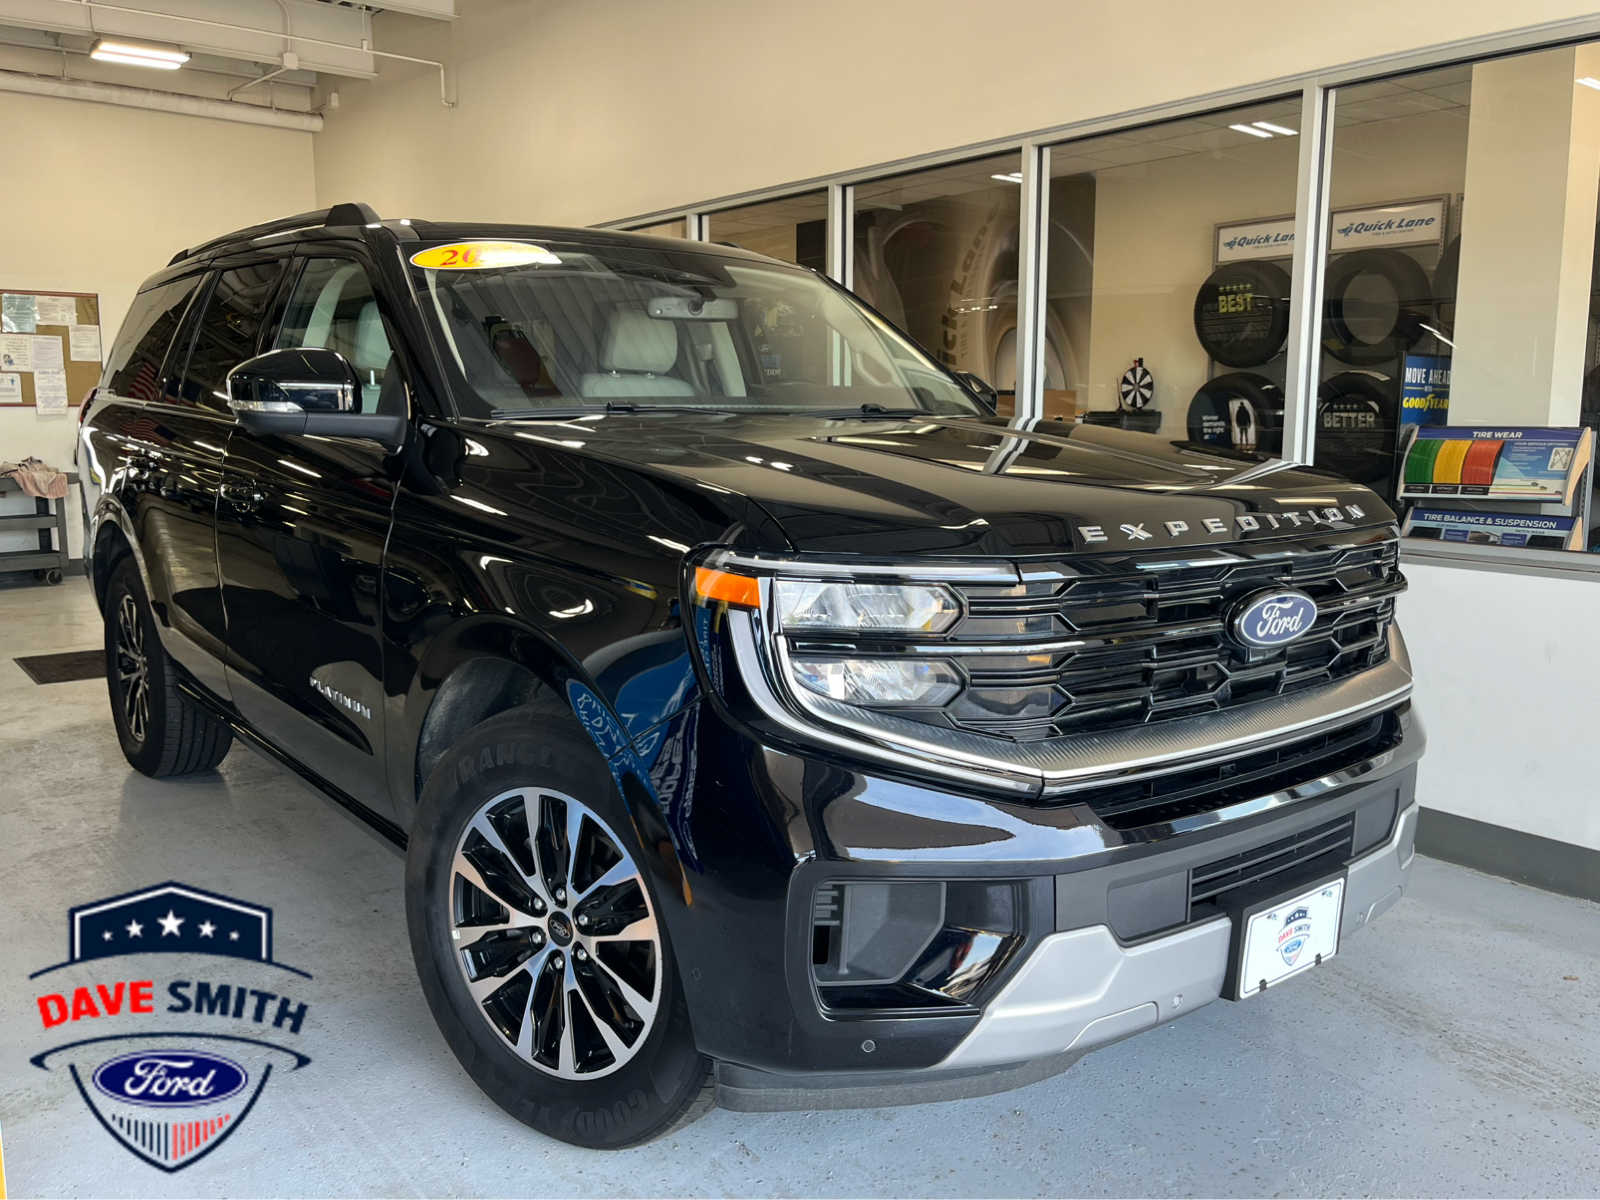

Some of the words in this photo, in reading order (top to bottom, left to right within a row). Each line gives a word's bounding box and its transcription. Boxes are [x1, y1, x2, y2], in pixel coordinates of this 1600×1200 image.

[1352, 219, 1393, 234] Quick
[1396, 216, 1436, 229] Lane
[1237, 233, 1272, 248] Quick
[1273, 232, 1296, 242] Lan
[1218, 293, 1252, 313] BEST
[1405, 368, 1426, 383] MOVE
[1323, 411, 1375, 428] BETTER
[1473, 431, 1493, 439] TIRE
[1494, 431, 1523, 439] WEAR
[1077, 504, 1367, 544] EXPEDITION
[1423, 513, 1443, 521] TIRE
[1443, 514, 1485, 524] BALANCE
[1486, 517, 1493, 525] &
[1494, 518, 1557, 529] SUSPENSION
[1256, 601, 1304, 638] Ford
